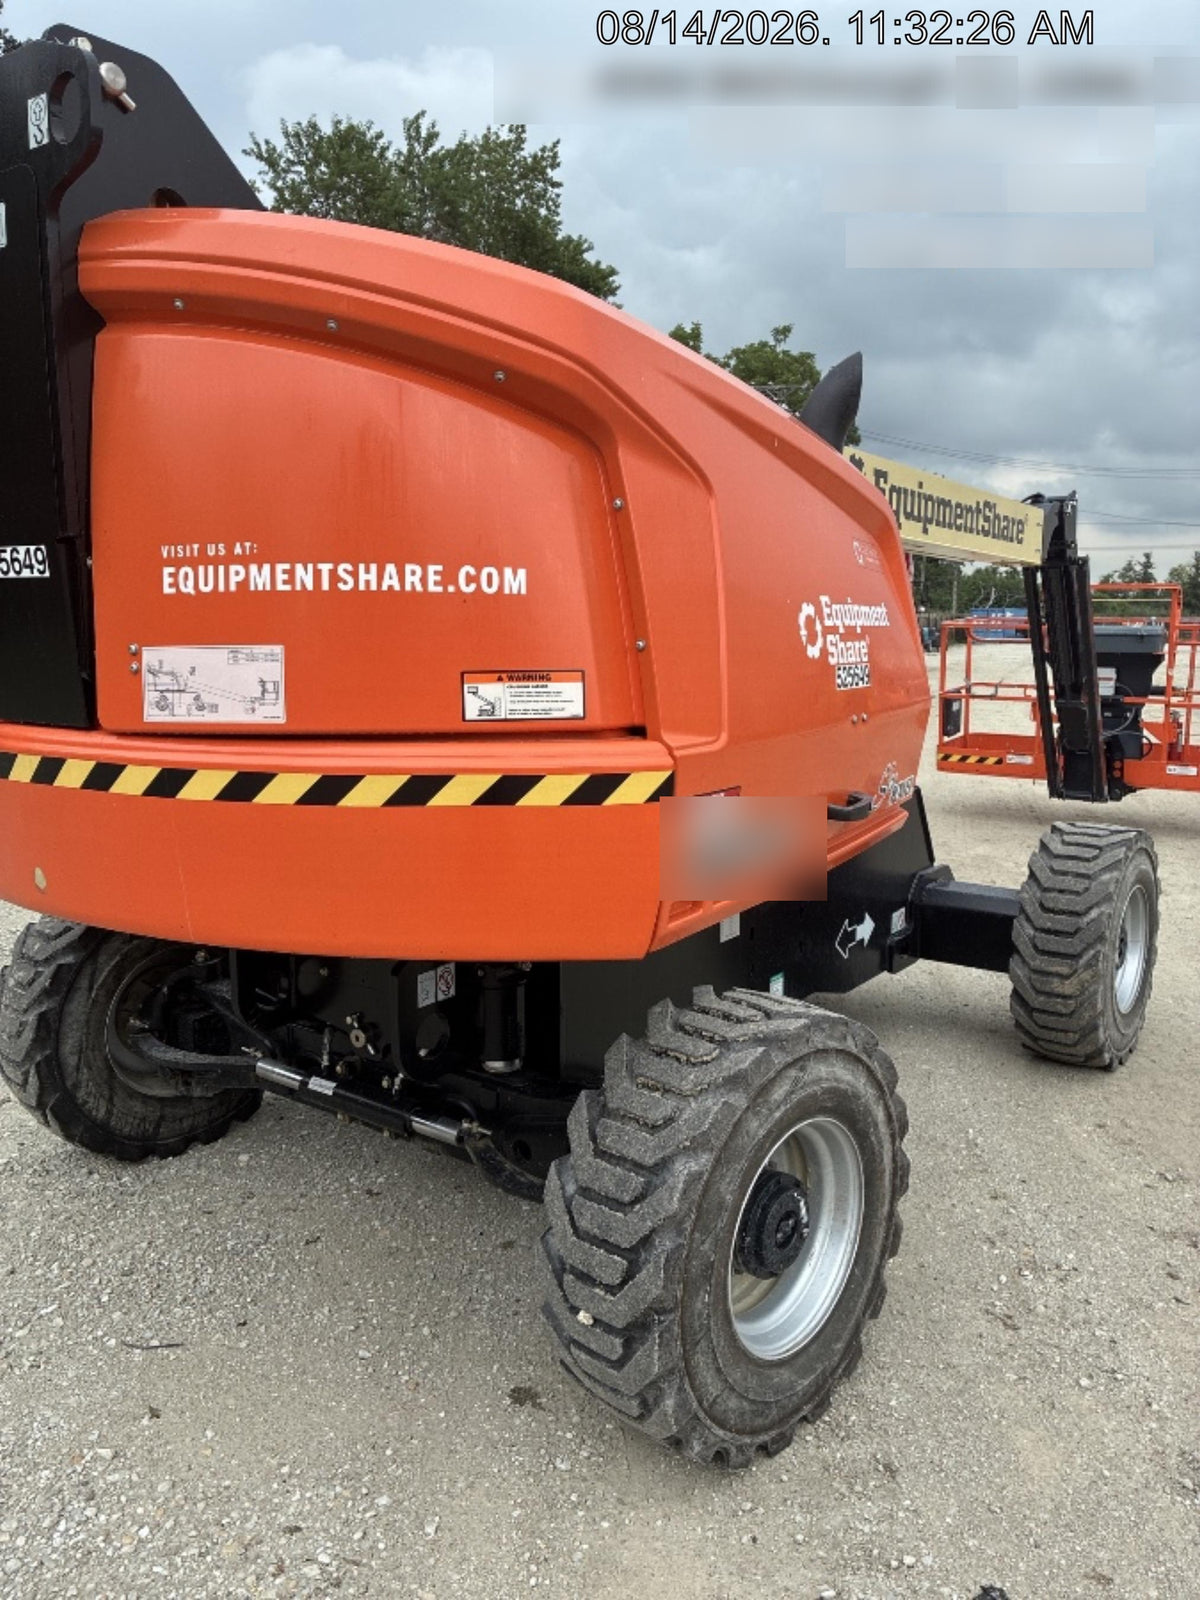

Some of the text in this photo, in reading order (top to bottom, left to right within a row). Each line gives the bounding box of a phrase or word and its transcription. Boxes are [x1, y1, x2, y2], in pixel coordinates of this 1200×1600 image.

[161, 541, 258, 559] VISIT US AT:
[162, 563, 528, 596] EQUIPMENTSHARE.COM
[819, 595, 890, 633] Equipment
[826, 634, 869, 666] Share
[506, 673, 552, 682] WARNING
